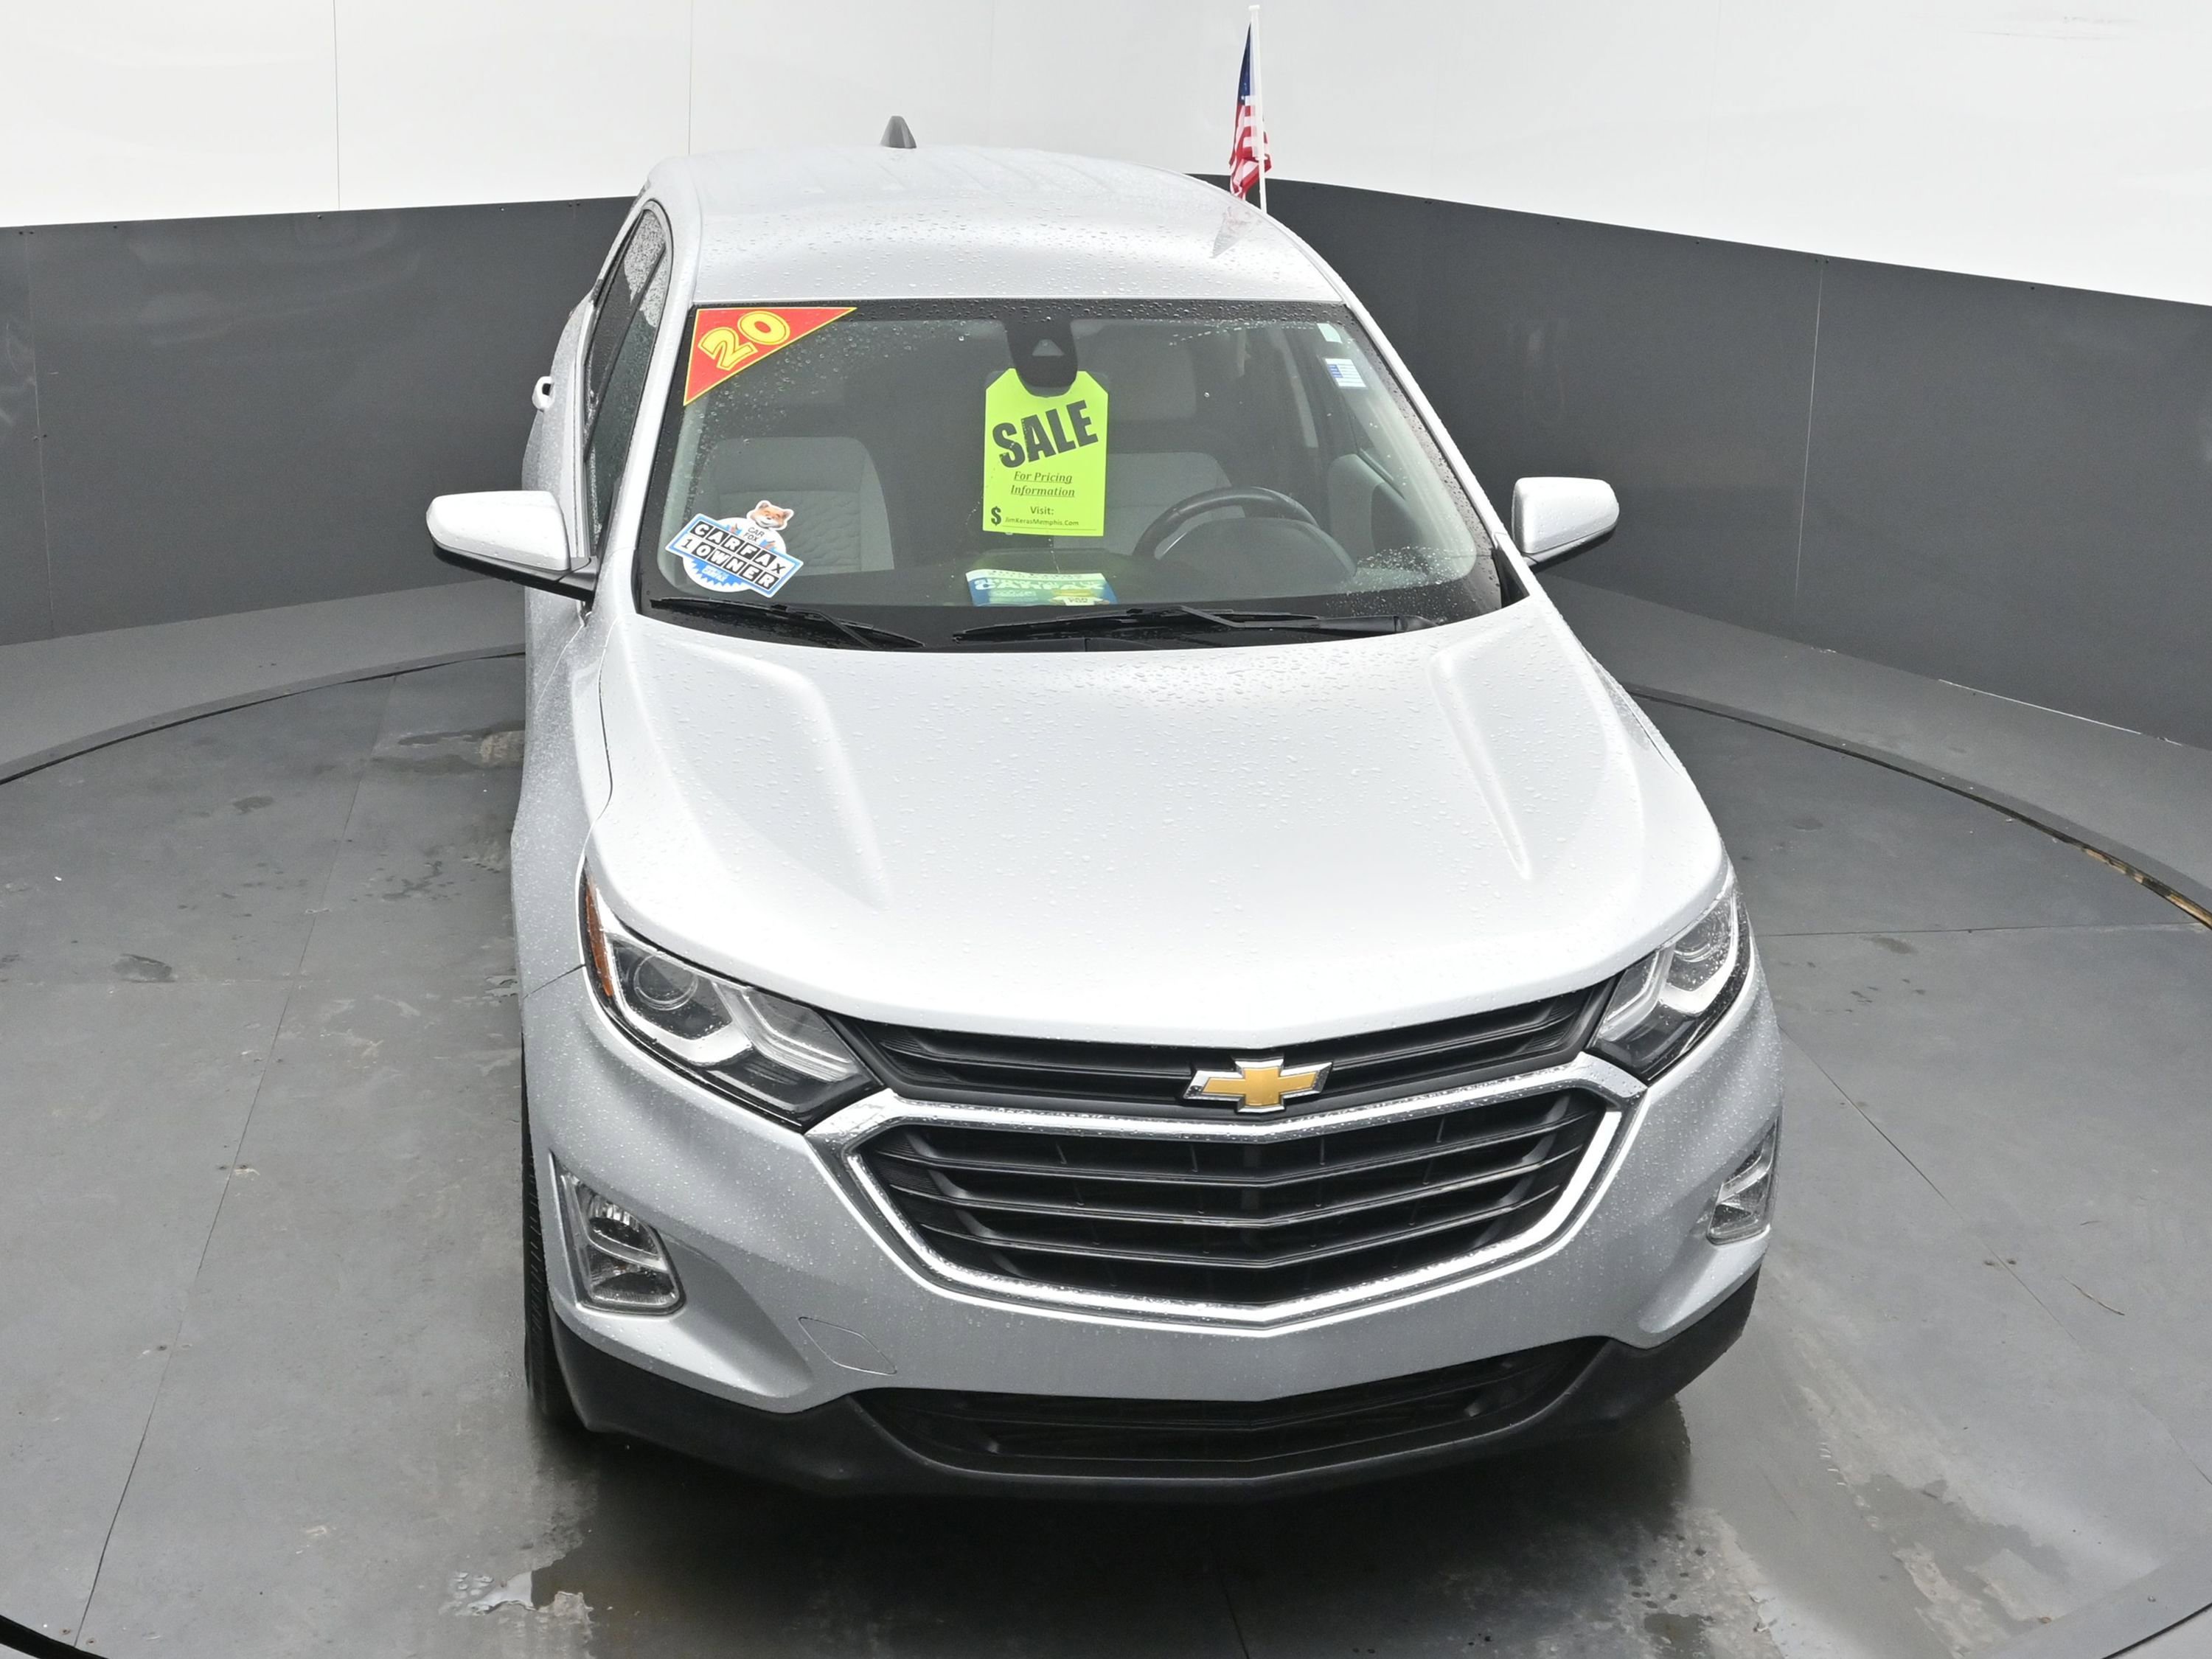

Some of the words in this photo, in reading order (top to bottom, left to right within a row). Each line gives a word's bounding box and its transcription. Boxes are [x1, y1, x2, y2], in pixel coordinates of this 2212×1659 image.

[698, 310, 791, 371] 20
[992, 400, 1099, 468] SALE
[1014, 471, 1032, 481] For
[1034, 472, 1073, 484] Pricing
[1010, 484, 1075, 498] Information
[990, 506, 1001, 526] $
[1030, 506, 1054, 515] Visit:
[1004, 517, 1079, 526] JimKerasMemphis.Com
[743, 532, 759, 543] FOX
[747, 526, 765, 538] CAR
[692, 521, 787, 575] CARFAX
[680, 538, 693, 550] 1
[694, 543, 777, 589] OWNER
